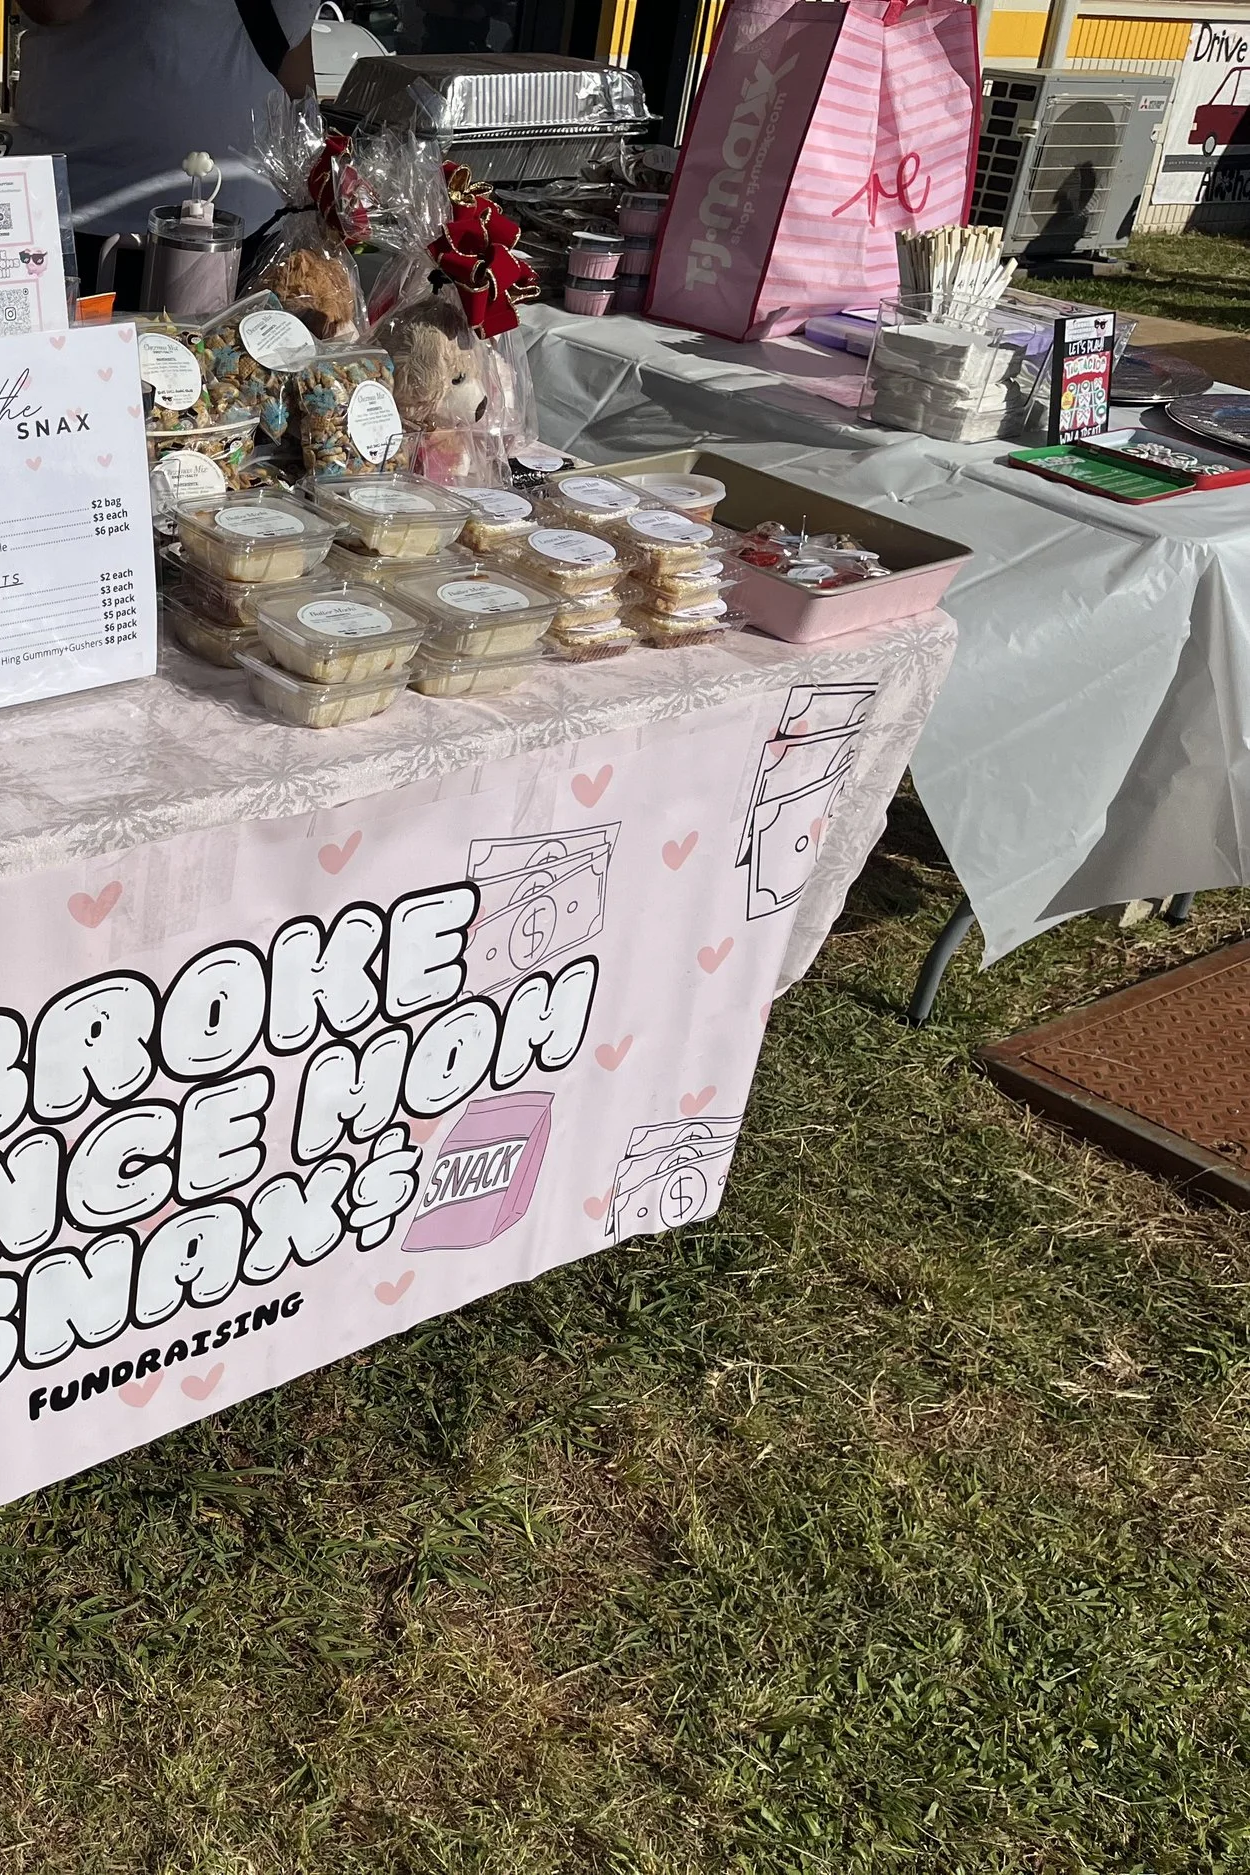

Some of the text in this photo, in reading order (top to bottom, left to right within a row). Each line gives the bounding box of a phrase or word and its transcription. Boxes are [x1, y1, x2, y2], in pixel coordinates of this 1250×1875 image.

[1193, 22, 1248, 62] Drive
[730, 202, 756, 246] shop
[1069, 341, 1086, 355] LET'S
[17, 413, 91, 440] SNAX
[91, 499, 103, 510] $2
[104, 497, 122, 510] bag
[93, 511, 104, 523] $3
[106, 509, 128, 521] each
[94, 525, 106, 537] $6
[108, 523, 130, 537] pack
[100, 572, 111, 583] $2
[112, 568, 134, 580] each
[100, 585, 111, 596] $3
[112, 581, 134, 593] each
[101, 597, 113, 608] $3
[114, 594, 135, 608] pack
[103, 610, 114, 621] $5
[115, 606, 137, 620] pack
[104, 622, 115, 633] $6
[116, 618, 138, 632] pack
[1, 654, 21, 667] Hing
[104, 634, 115, 645] $8
[116, 631, 138, 645] pack
[292, 957, 599, 1164] MOM
[423, 1142, 523, 1210] SNACK
[29, 1292, 306, 1422] FUNDRAISING
